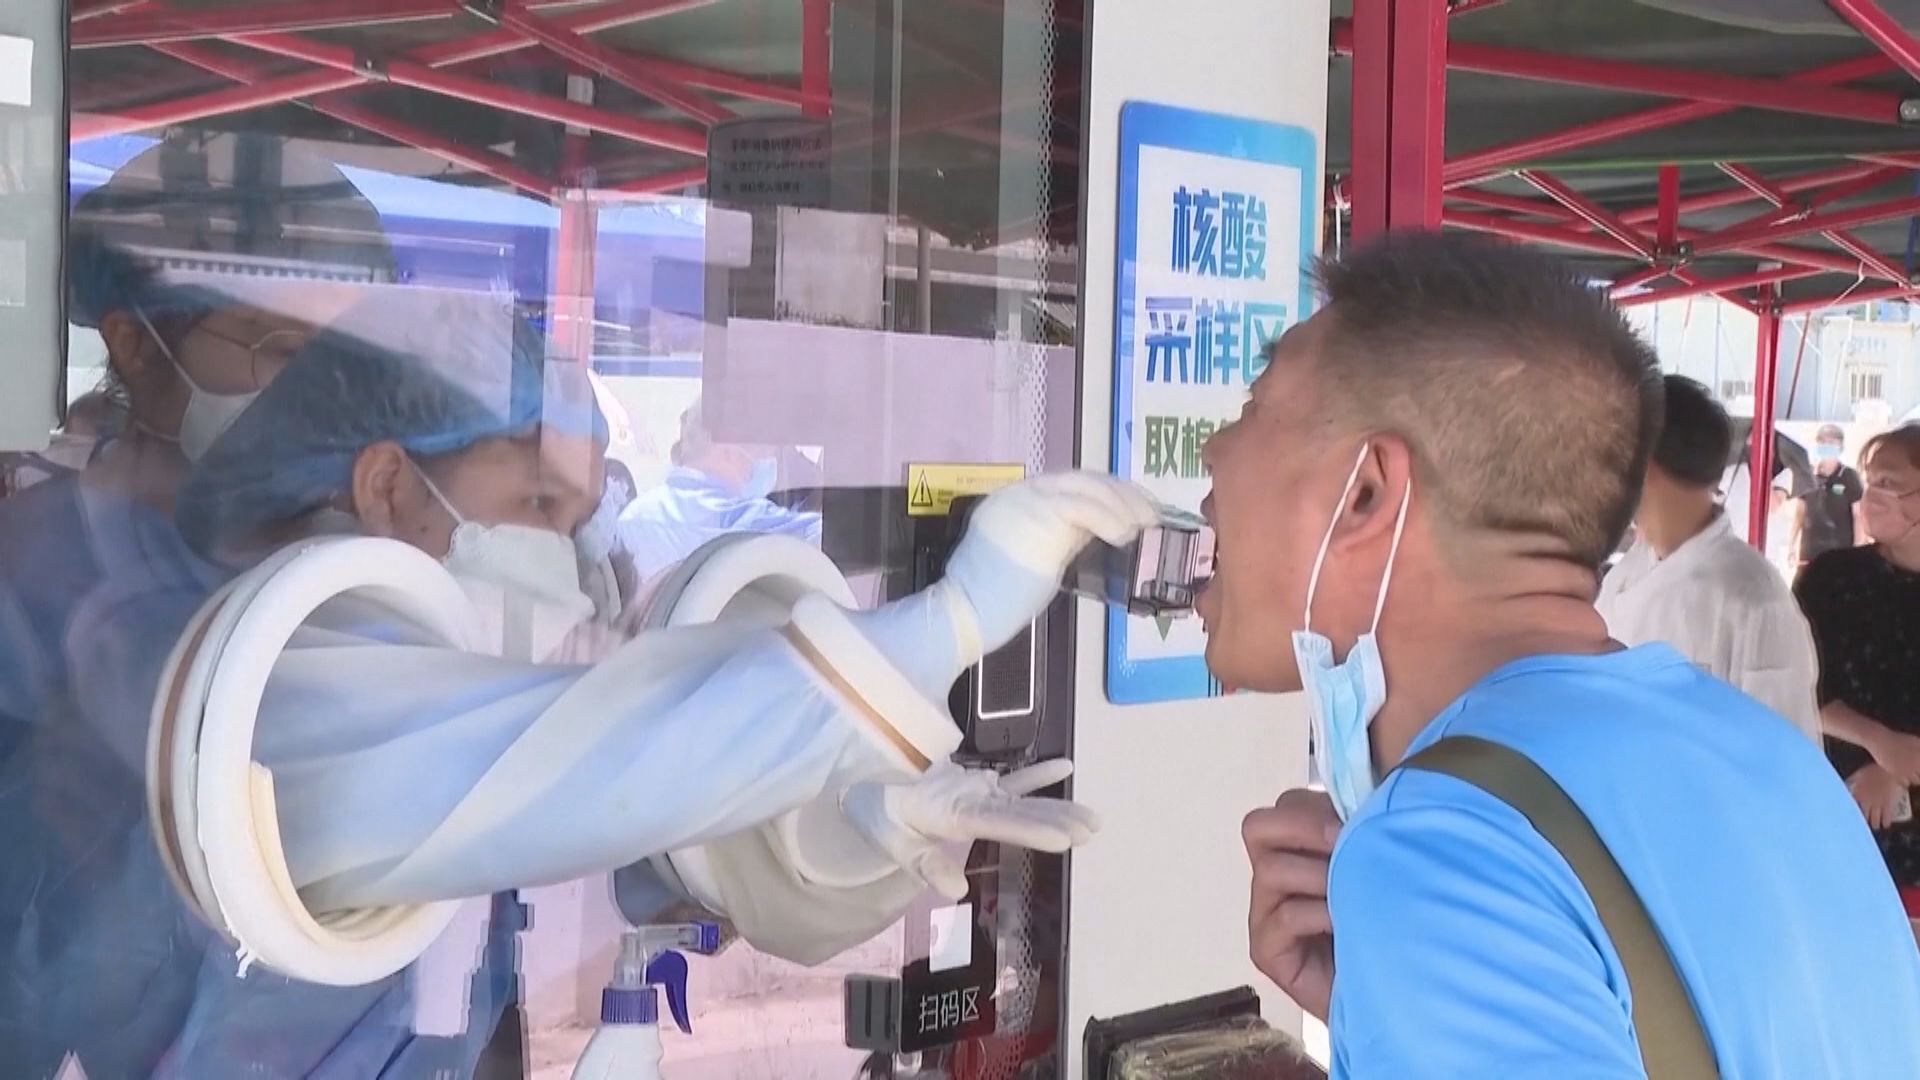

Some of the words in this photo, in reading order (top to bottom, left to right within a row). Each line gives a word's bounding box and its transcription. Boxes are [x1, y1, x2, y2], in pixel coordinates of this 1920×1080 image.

[1172, 186, 1266, 280] 核酸
[1145, 296, 1287, 385] 采样区
[1144, 416, 1228, 478] 取棉
[919, 986, 980, 1033] 扫码区
